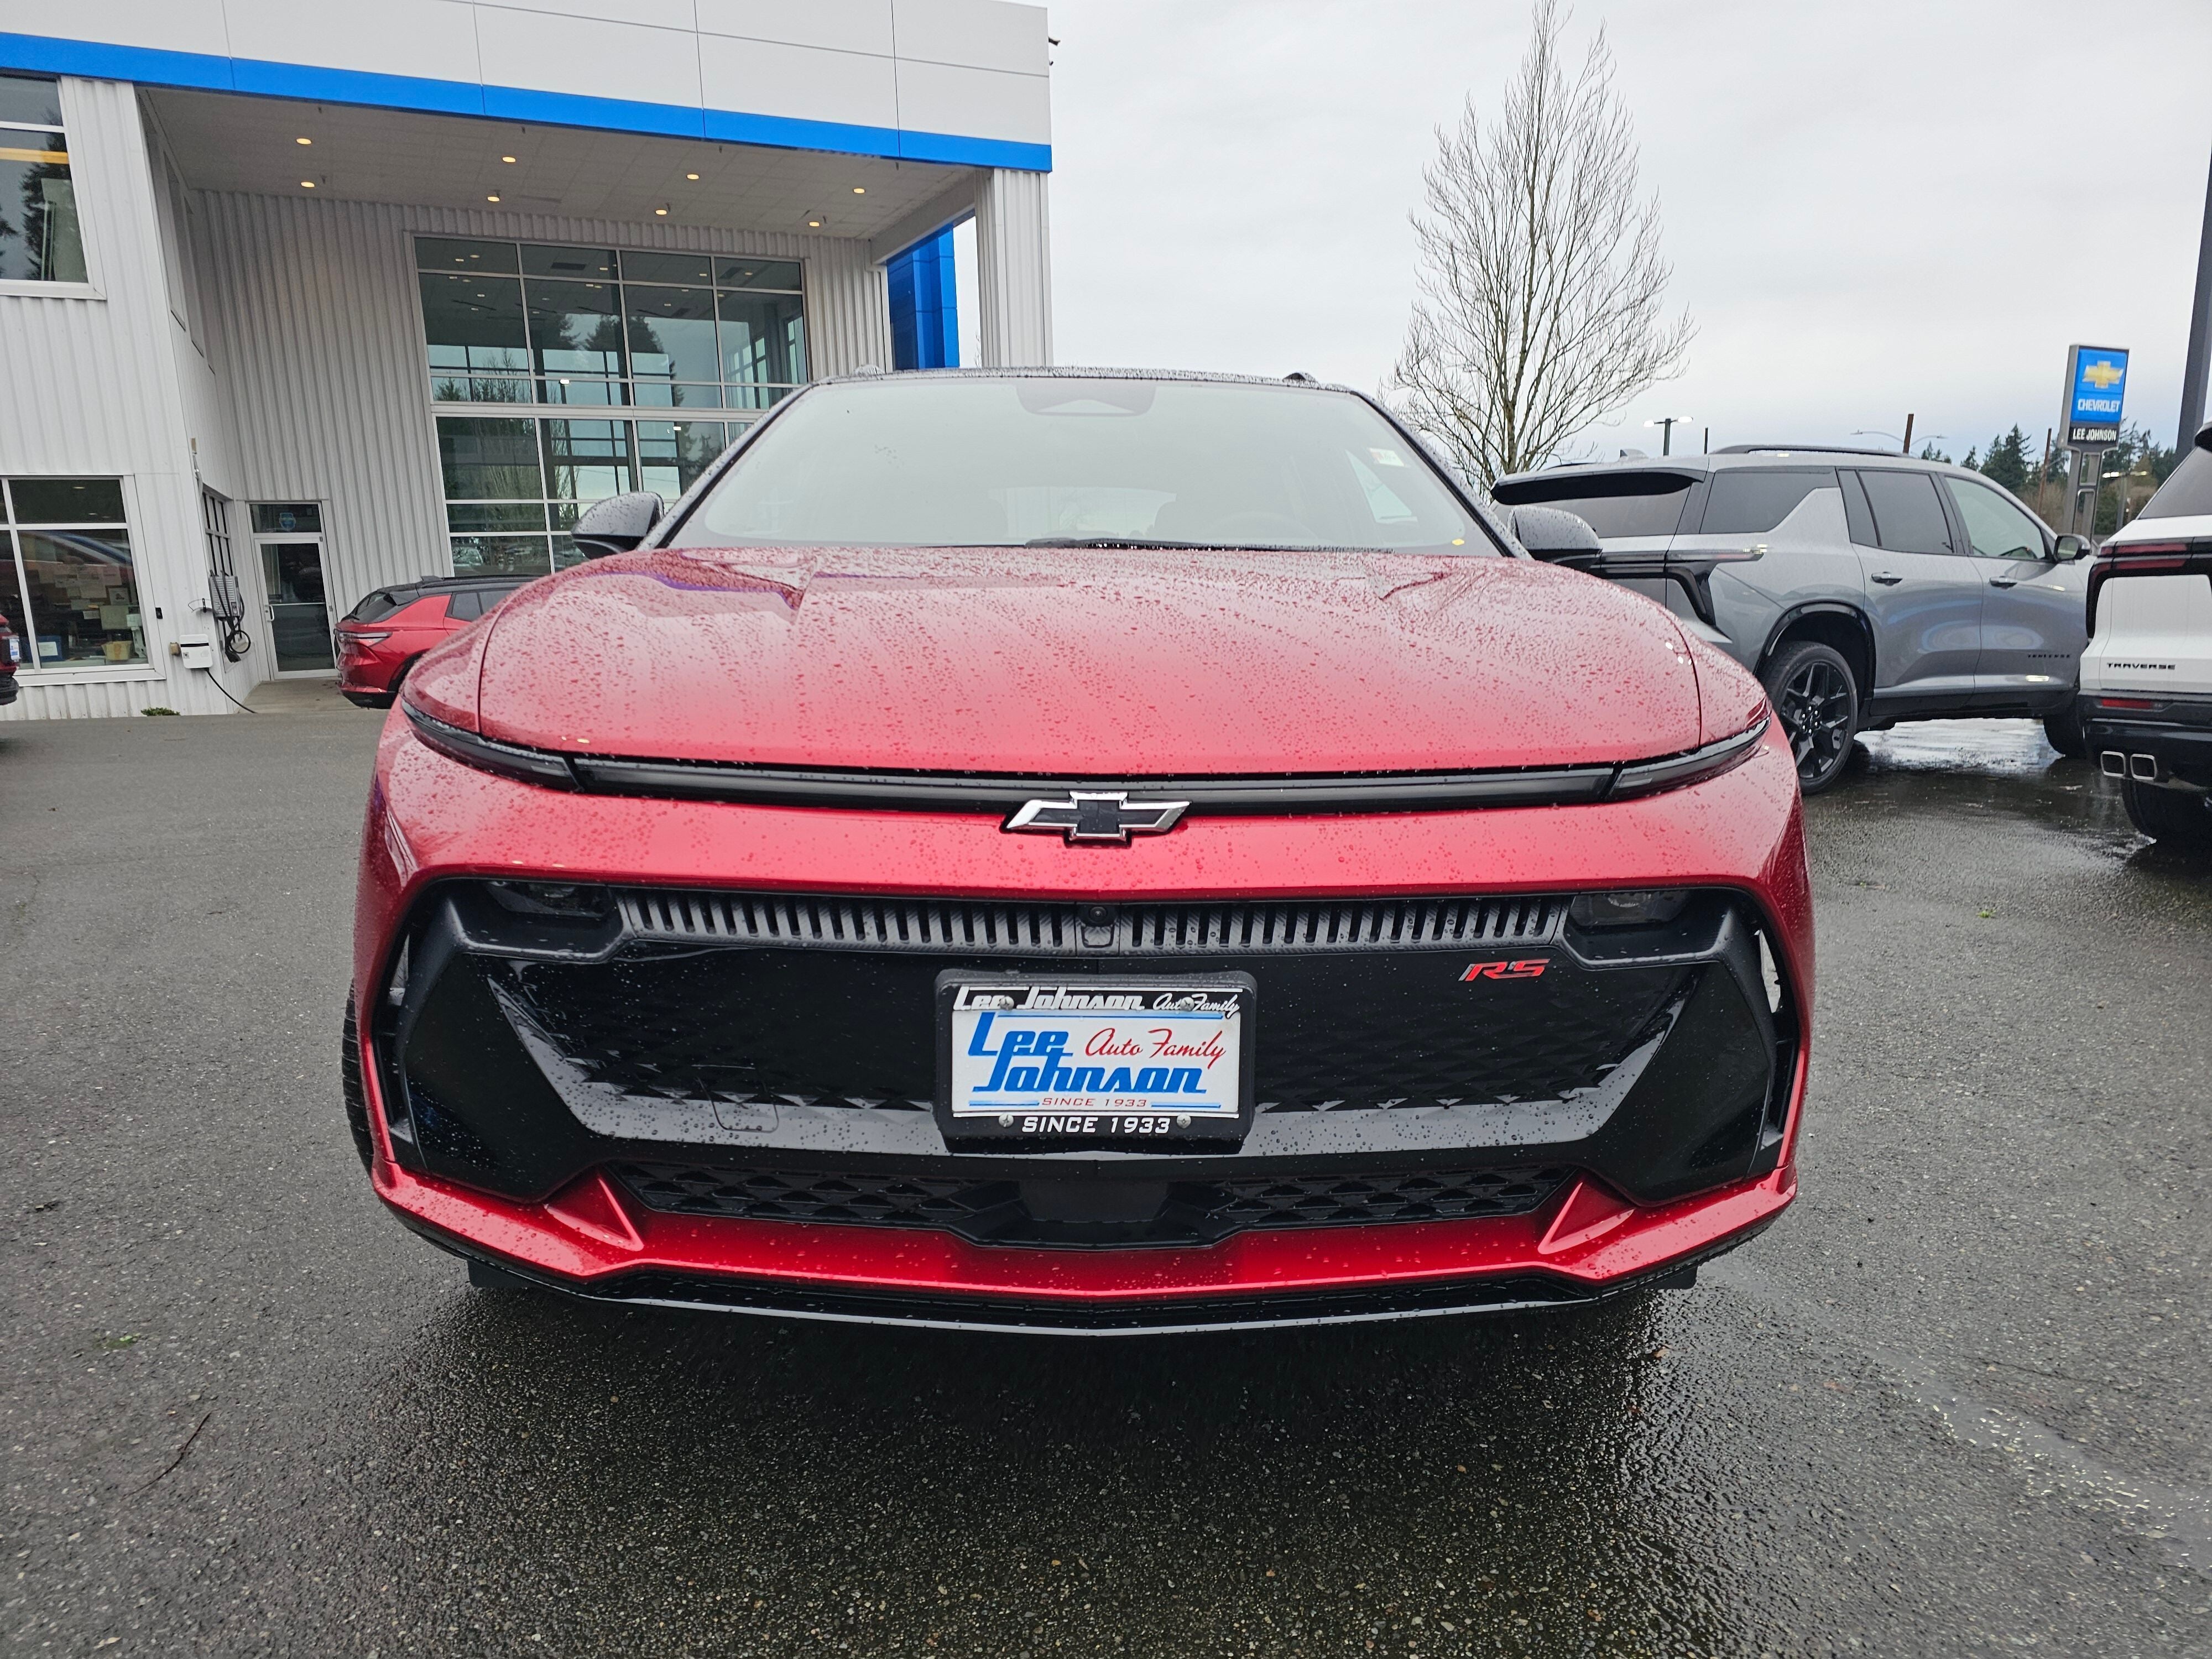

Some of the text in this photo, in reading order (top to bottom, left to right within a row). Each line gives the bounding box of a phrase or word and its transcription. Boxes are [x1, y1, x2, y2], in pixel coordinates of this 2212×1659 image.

[2078, 399, 2120, 413] CHEVROLET
[2073, 428, 2117, 441] LEE JOHNSON
[1458, 958, 1550, 982] RS
[1016, 986, 1145, 1010] Johnson
[1152, 993, 1187, 1011] Aut
[1191, 993, 1240, 1018] Family
[968, 1011, 1073, 1056] Lee
[1085, 1027, 1227, 1070] Auto Family
[972, 1045, 1207, 1094] Johnson
[1041, 1097, 1148, 1108] SINCE 1933
[1021, 1116, 1171, 1134] SINCE 1933
